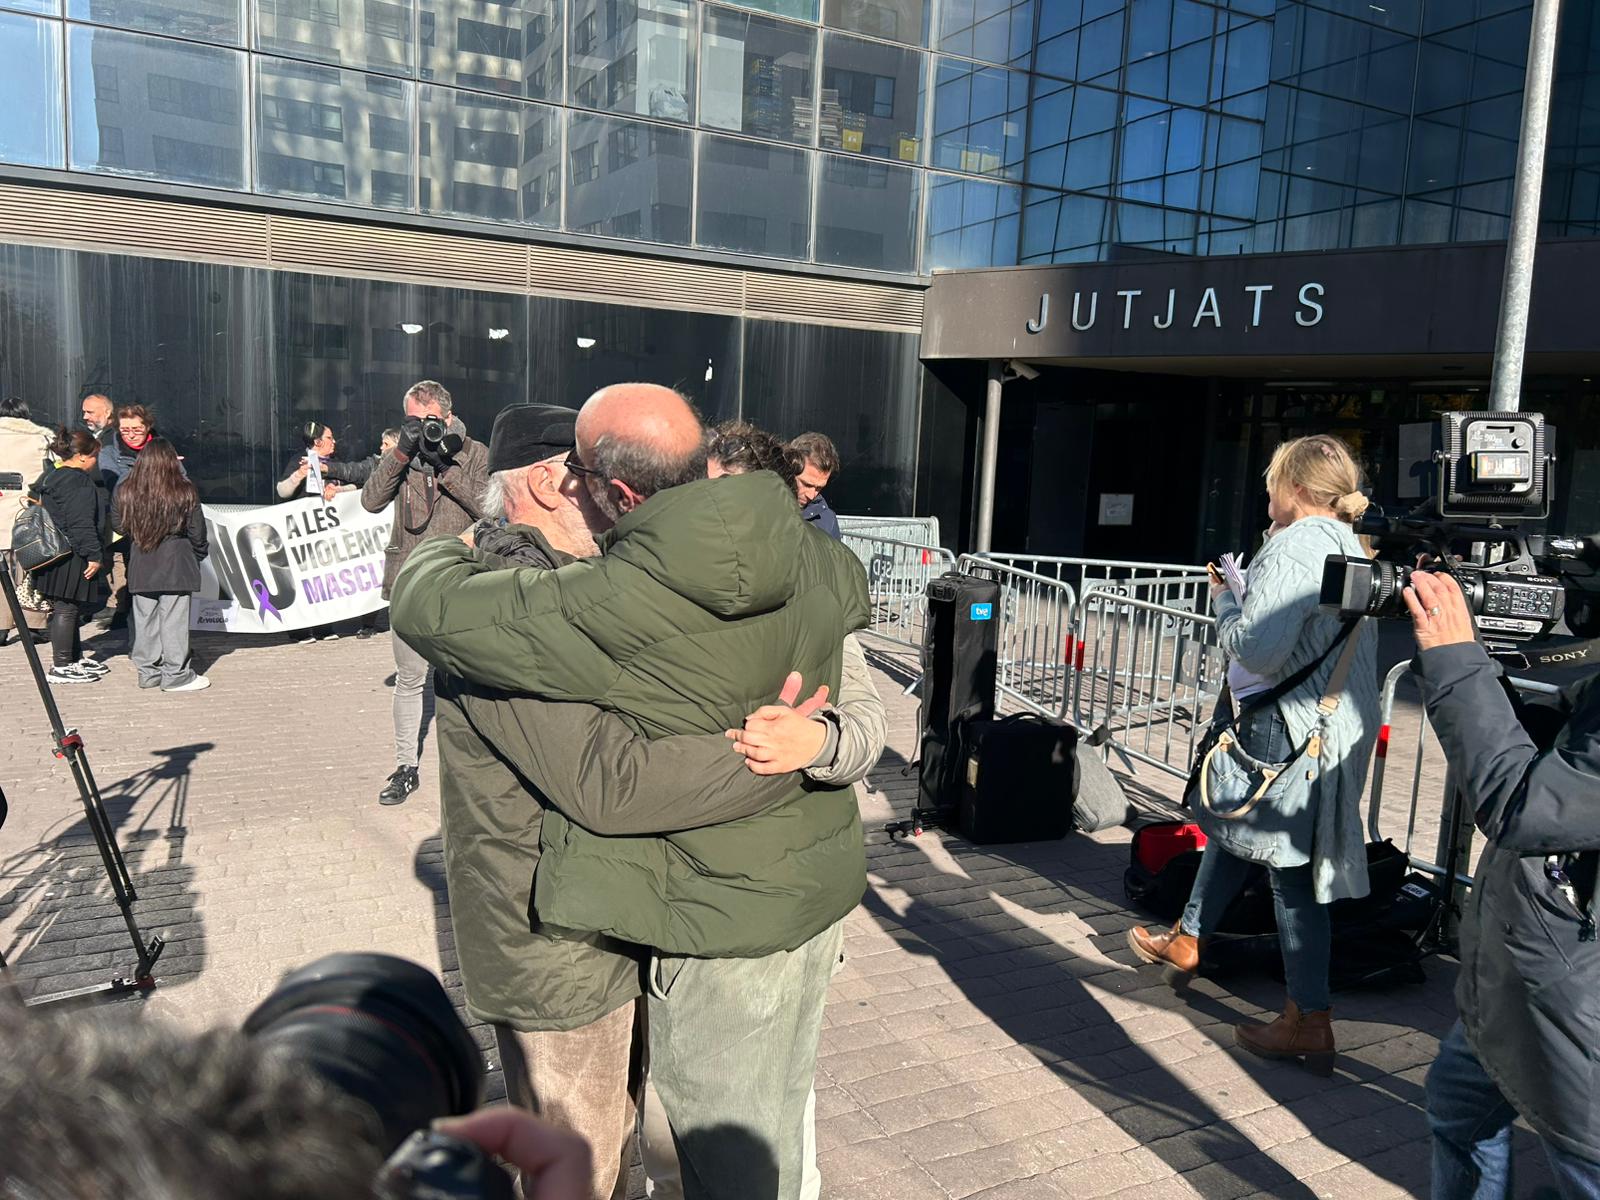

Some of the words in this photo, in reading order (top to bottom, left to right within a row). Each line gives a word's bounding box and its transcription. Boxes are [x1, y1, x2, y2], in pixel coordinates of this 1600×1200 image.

[1026, 282, 1325, 333] JUTJATS
[285, 514, 301, 540] A
[302, 505, 341, 531] LES
[206, 517, 297, 611] NO
[1527, 576, 1553, 584] SONY
[1539, 649, 1588, 663] SONY
